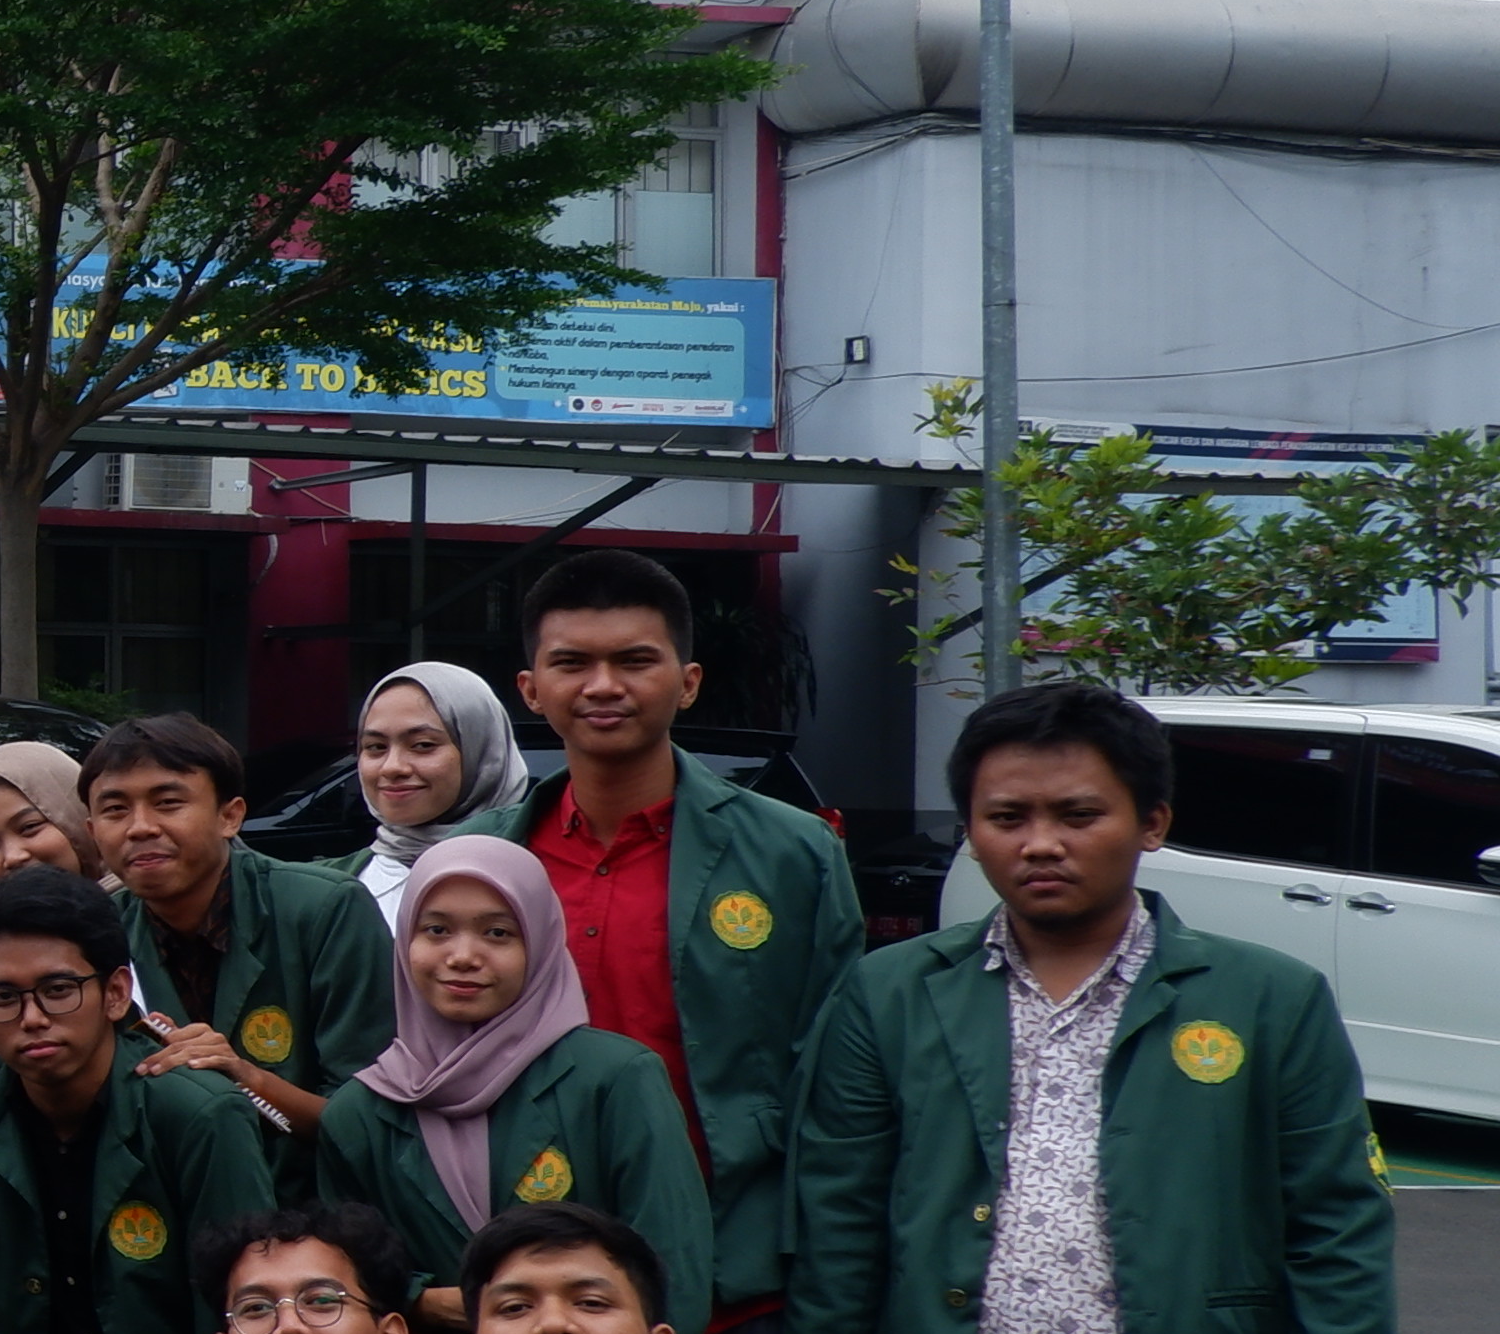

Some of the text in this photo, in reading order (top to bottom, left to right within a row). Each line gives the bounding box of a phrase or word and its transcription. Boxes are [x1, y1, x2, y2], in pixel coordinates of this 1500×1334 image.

[296, 363, 345, 392] TO
[355, 366, 486, 398] BICS
[508, 364, 566, 377] Membangun
